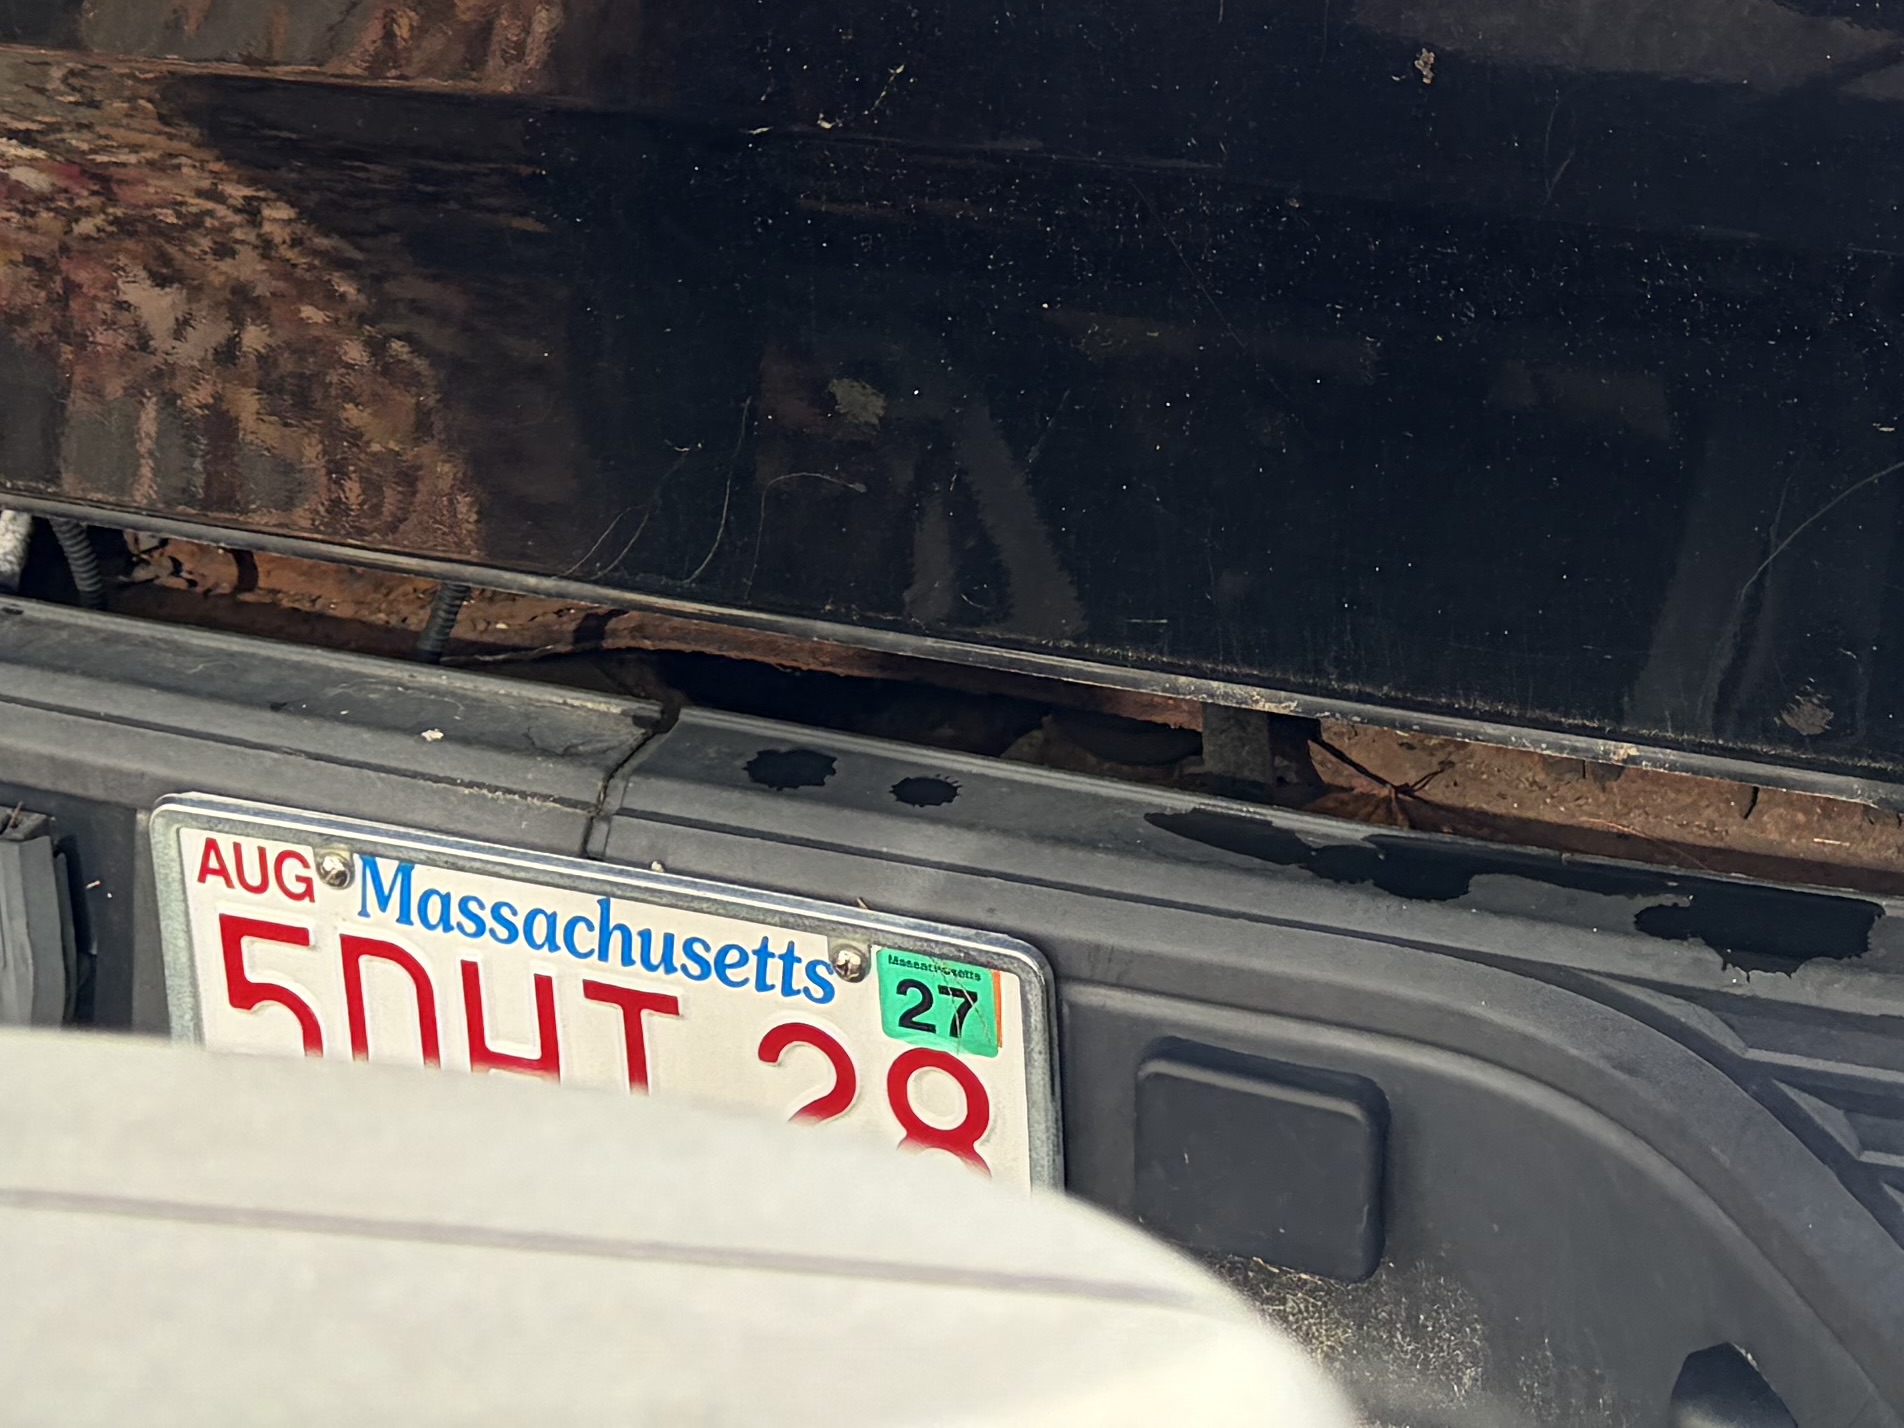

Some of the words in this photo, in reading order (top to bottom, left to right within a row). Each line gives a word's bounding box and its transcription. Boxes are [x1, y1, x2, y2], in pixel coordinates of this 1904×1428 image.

[197, 836, 317, 903] AUG
[357, 852, 836, 1005] Massachusetts
[895, 977, 979, 1039] 27
